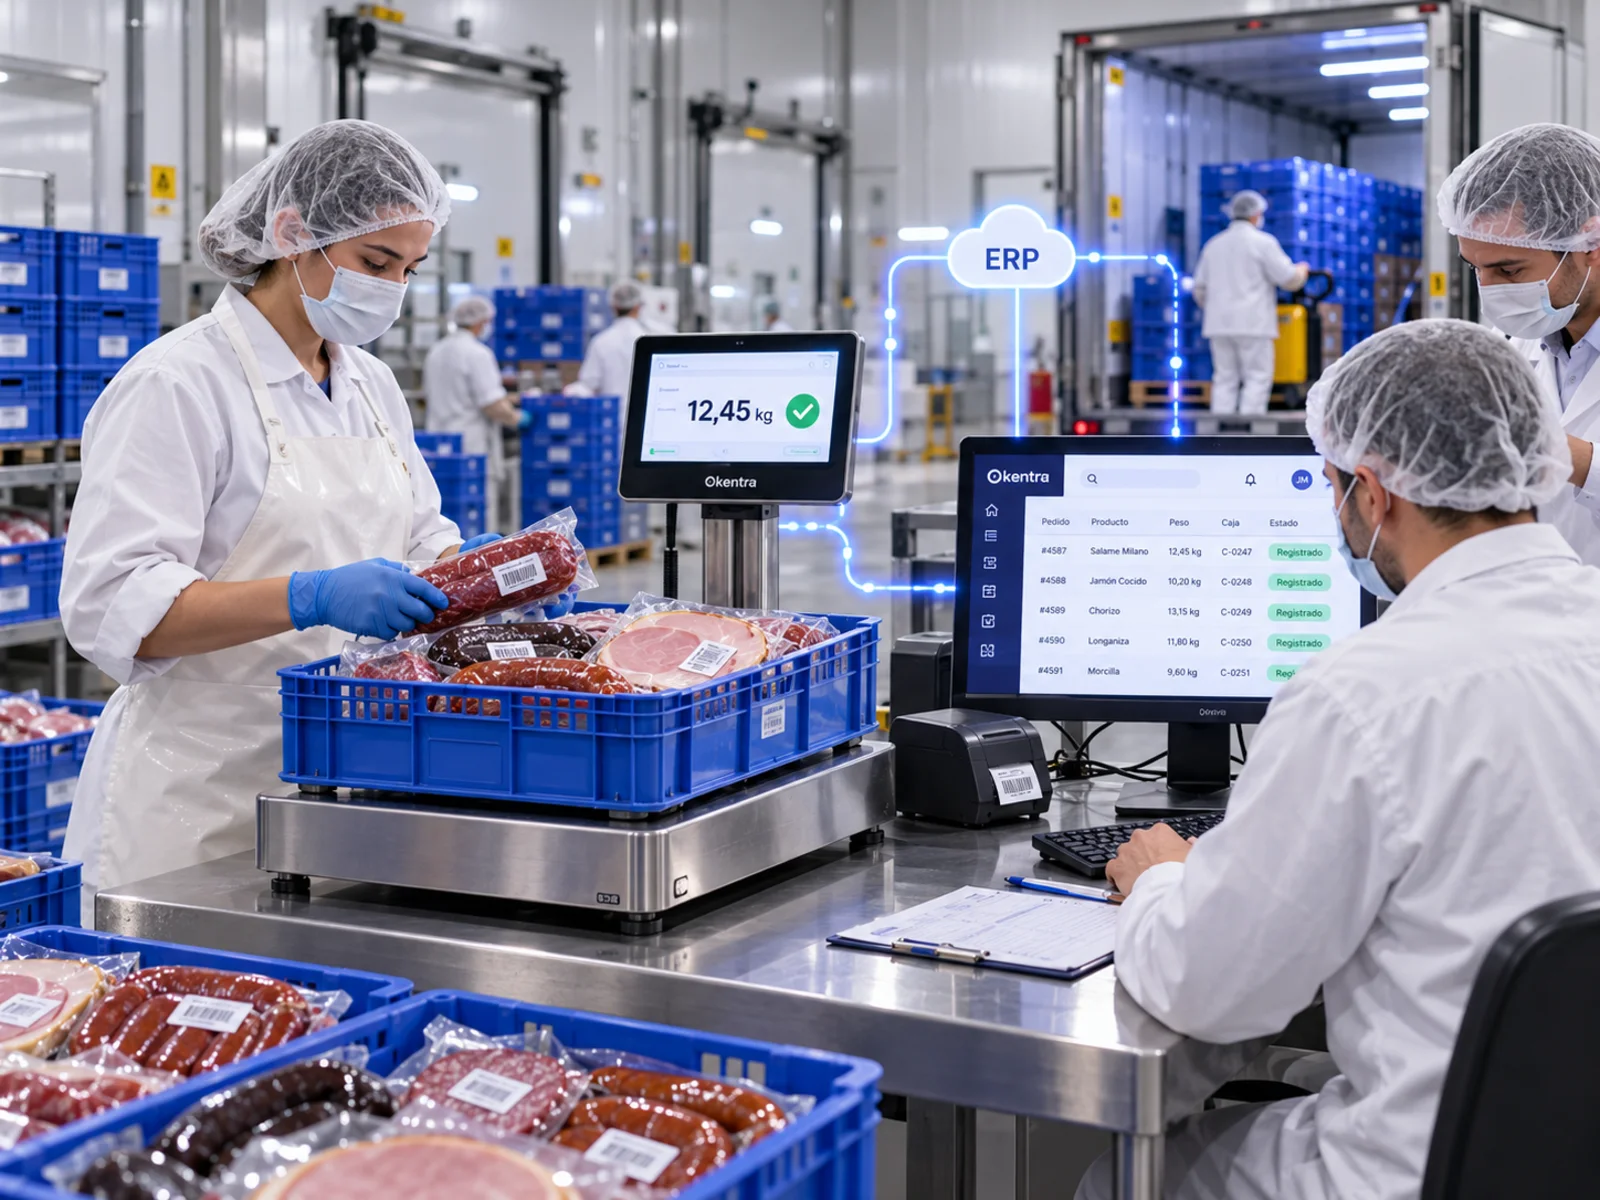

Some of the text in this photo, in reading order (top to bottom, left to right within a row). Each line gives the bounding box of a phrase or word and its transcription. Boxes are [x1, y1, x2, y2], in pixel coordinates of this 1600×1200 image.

[688, 400, 772, 425] 12,45 kg
[987, 469, 1049, 484] Okentra
[1296, 476, 1309, 485] JM
[705, 476, 756, 487] Okentra
[1042, 518, 1070, 526] Pedido
[1092, 518, 1128, 526] Producto
[1170, 518, 1189, 526] Peso
[1222, 519, 1240, 528] Caja
[1270, 519, 1298, 527] Estado
[1090, 547, 1119, 555] Salame
[1169, 548, 1202, 557] 12,45 kg
[1277, 548, 1323, 558] Registrado
[1041, 576, 1066, 584] #4588
[1090, 577, 1147, 585] Jamón Cocido
[1168, 578, 1201, 587] 10,20 kg
[1221, 578, 1252, 586] C-0248
[1277, 579, 1323, 588] Registrado
[1040, 606, 1065, 614] #4589
[1089, 607, 1120, 615] Chorizo
[1168, 608, 1200, 617] 13,15 kg
[1221, 608, 1252, 616] C-0249
[1276, 609, 1322, 618] Registrado
[1039, 636, 1065, 644] #4590
[1088, 637, 1129, 646] Longaniza
[1167, 638, 1199, 647] 11,80 kg
[1221, 638, 1252, 646] C-0250
[1276, 639, 1322, 649] Registrado
[1168, 668, 1198, 678] 9,60 kg
